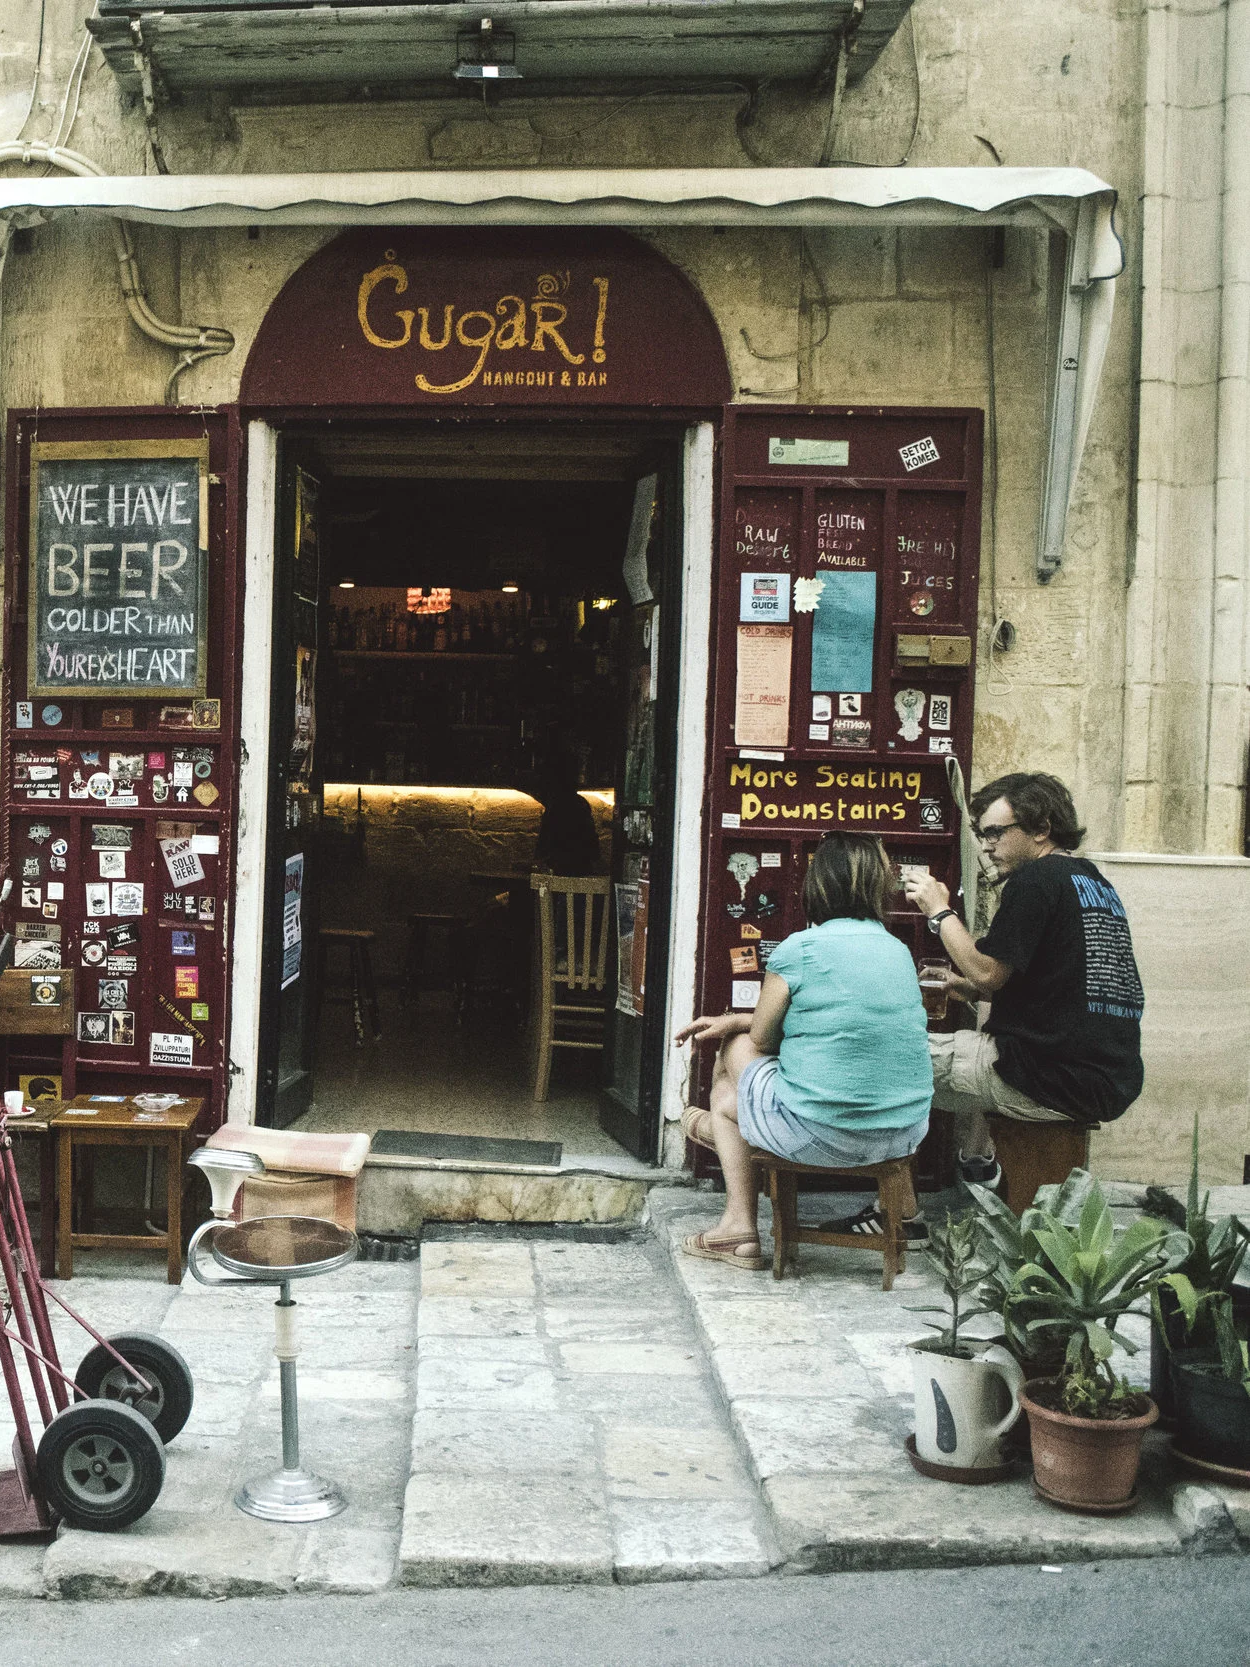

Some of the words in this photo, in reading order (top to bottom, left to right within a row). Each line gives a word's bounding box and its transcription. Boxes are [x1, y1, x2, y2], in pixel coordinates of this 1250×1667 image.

[483, 371, 553, 386] HANGOUT
[561, 371, 570, 386] &
[577, 371, 608, 386] BAR
[901, 438, 932, 459] SETOP
[904, 449, 938, 471] KOMER
[49, 484, 99, 526] WE
[107, 482, 192, 528] HAVE
[817, 513, 865, 531] GLUTEN
[745, 525, 779, 543] RAW
[736, 541, 790, 559] Desrt
[817, 552, 867, 567] AVAILABLE
[47, 540, 188, 600] BEER
[901, 570, 954, 590] JUCES
[751, 602, 779, 610] GUIDE
[47, 606, 142, 635] COLDER
[145, 612, 194, 635] THAN
[117, 648, 195, 683] HEART
[729, 763, 798, 788] More
[816, 765, 921, 800] Seating
[741, 793, 906, 821] Downstairs
[165, 839, 191, 858] RAW
[172, 854, 195, 870] SOLD
[174, 864, 199, 880] HERE
